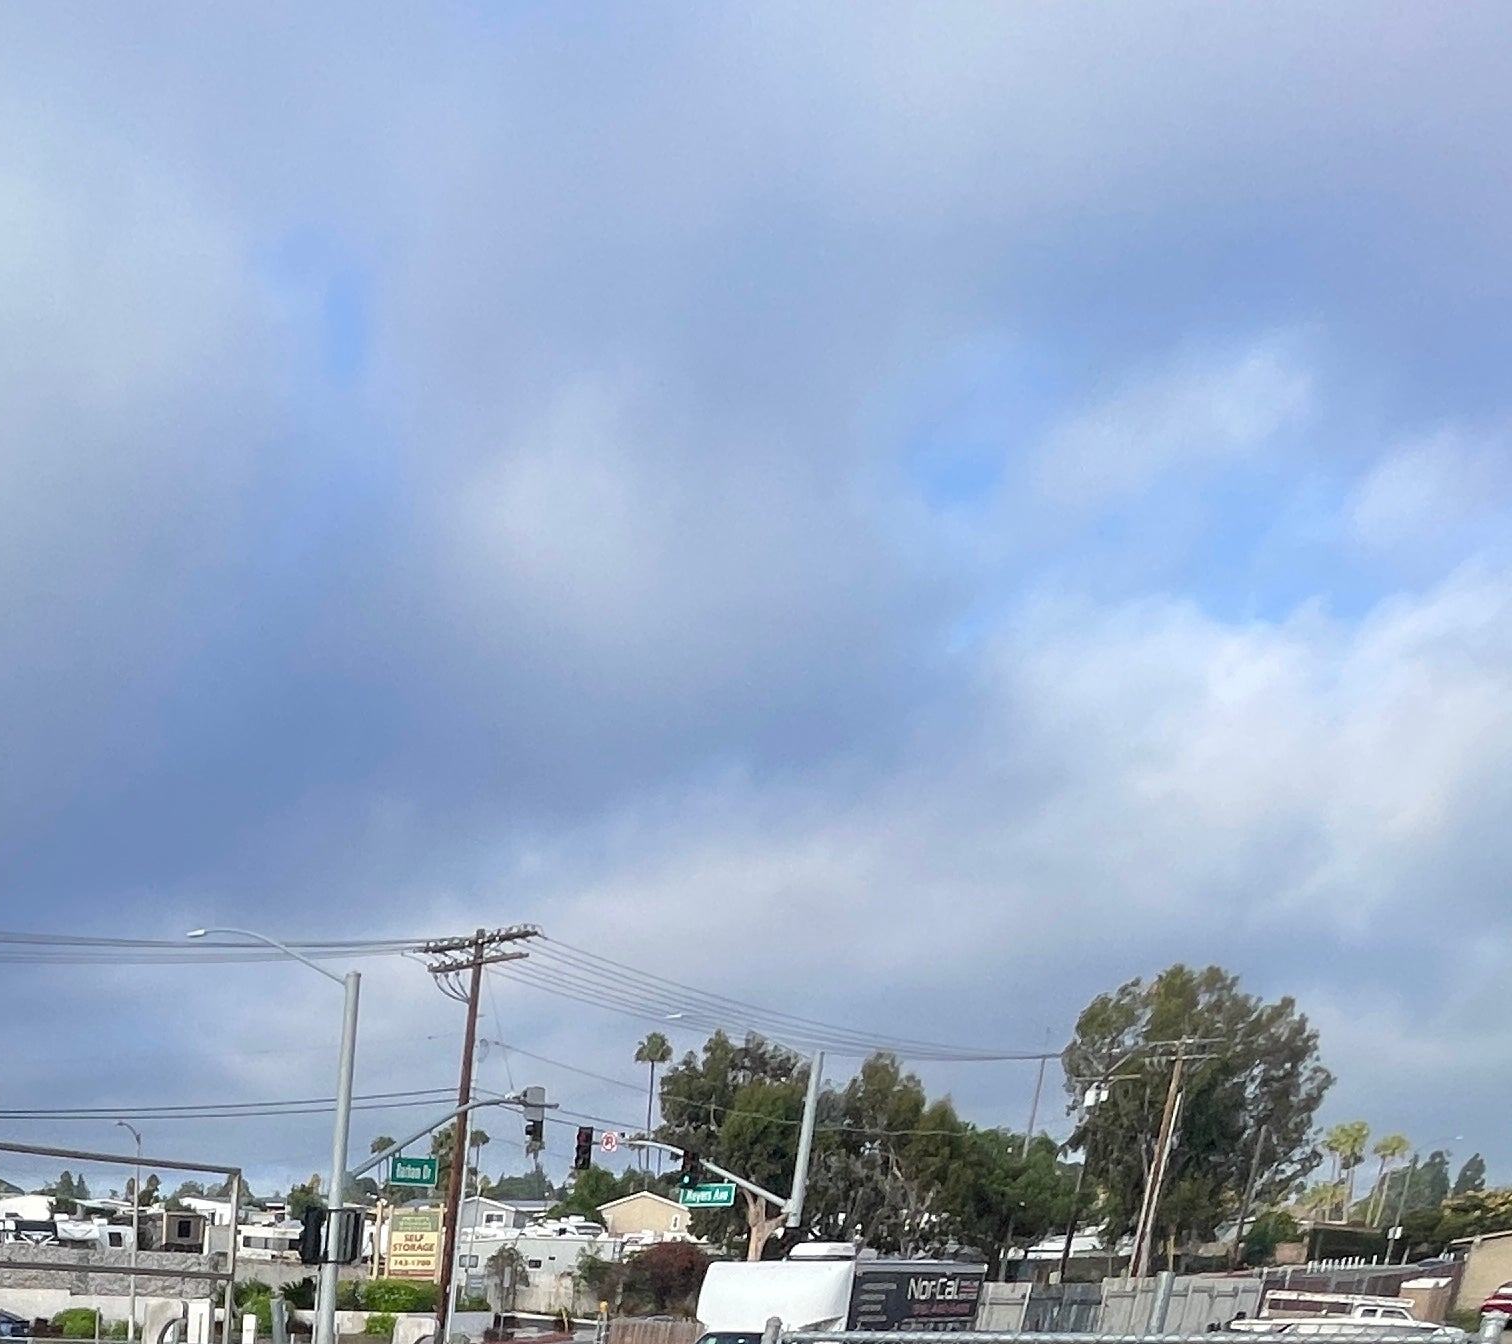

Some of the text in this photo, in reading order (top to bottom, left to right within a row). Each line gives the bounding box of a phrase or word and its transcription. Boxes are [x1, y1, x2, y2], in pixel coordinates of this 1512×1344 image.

[713, 1188, 729, 1201] Ave
[404, 1233, 424, 1242] SELF
[392, 1242, 435, 1252] STORAGE
